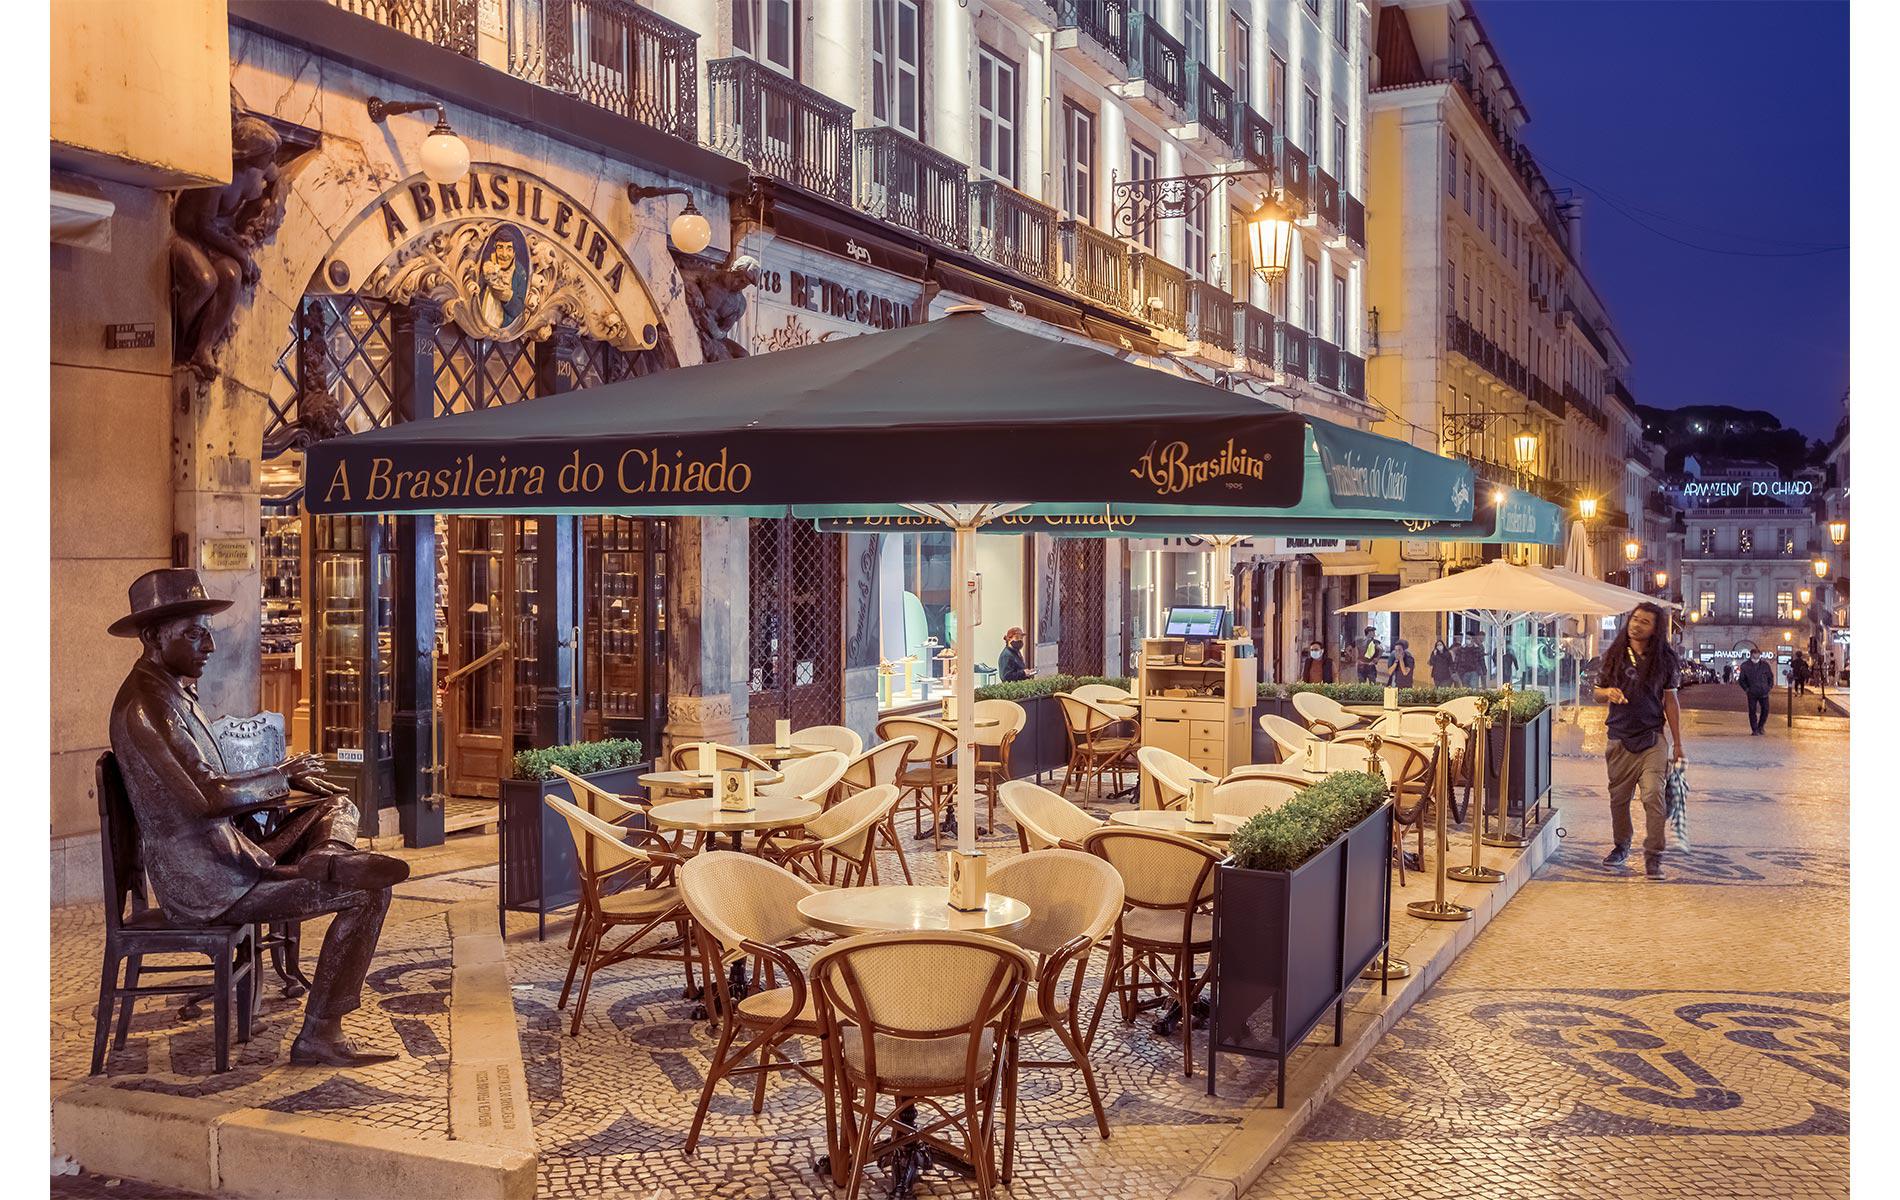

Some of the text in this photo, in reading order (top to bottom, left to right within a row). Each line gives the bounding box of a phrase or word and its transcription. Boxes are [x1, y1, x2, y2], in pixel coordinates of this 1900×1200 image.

[382, 173, 625, 294] A BRASILEIRA
[416, 338, 433, 356] 122
[557, 360, 571, 376] 120
[324, 447, 752, 502] A Brasileira do Chiado
[1130, 438, 1263, 495] A Brasileira
[1683, 481, 1813, 497] ARMAZENS DO CHIADO
